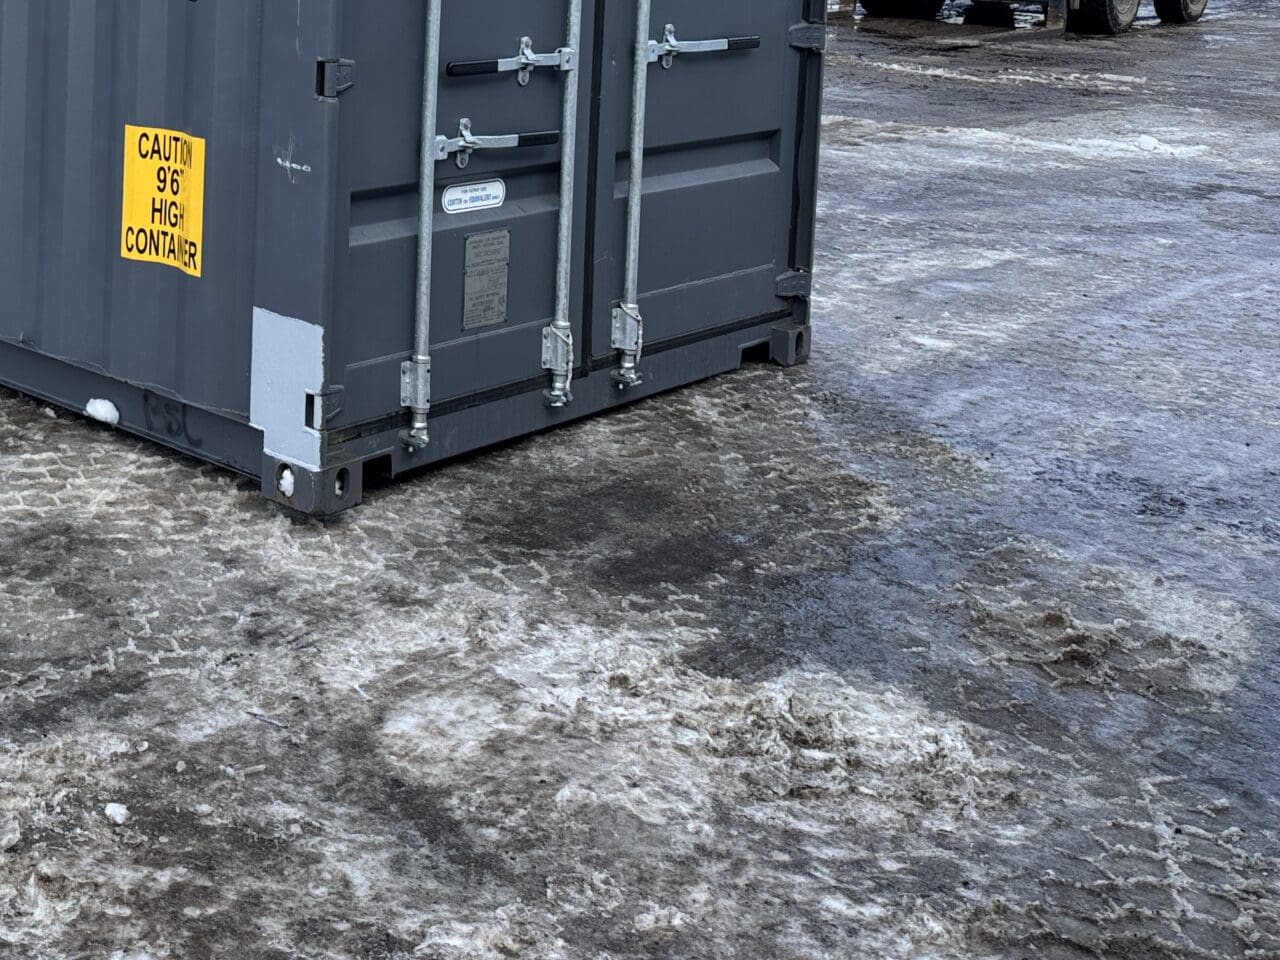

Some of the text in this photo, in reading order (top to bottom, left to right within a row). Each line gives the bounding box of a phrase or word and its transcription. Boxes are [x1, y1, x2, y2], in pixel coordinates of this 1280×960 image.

[138, 132, 192, 169] CAUTION
[151, 197, 185, 232] HIGH
[125, 226, 197, 271] CONTAINER
